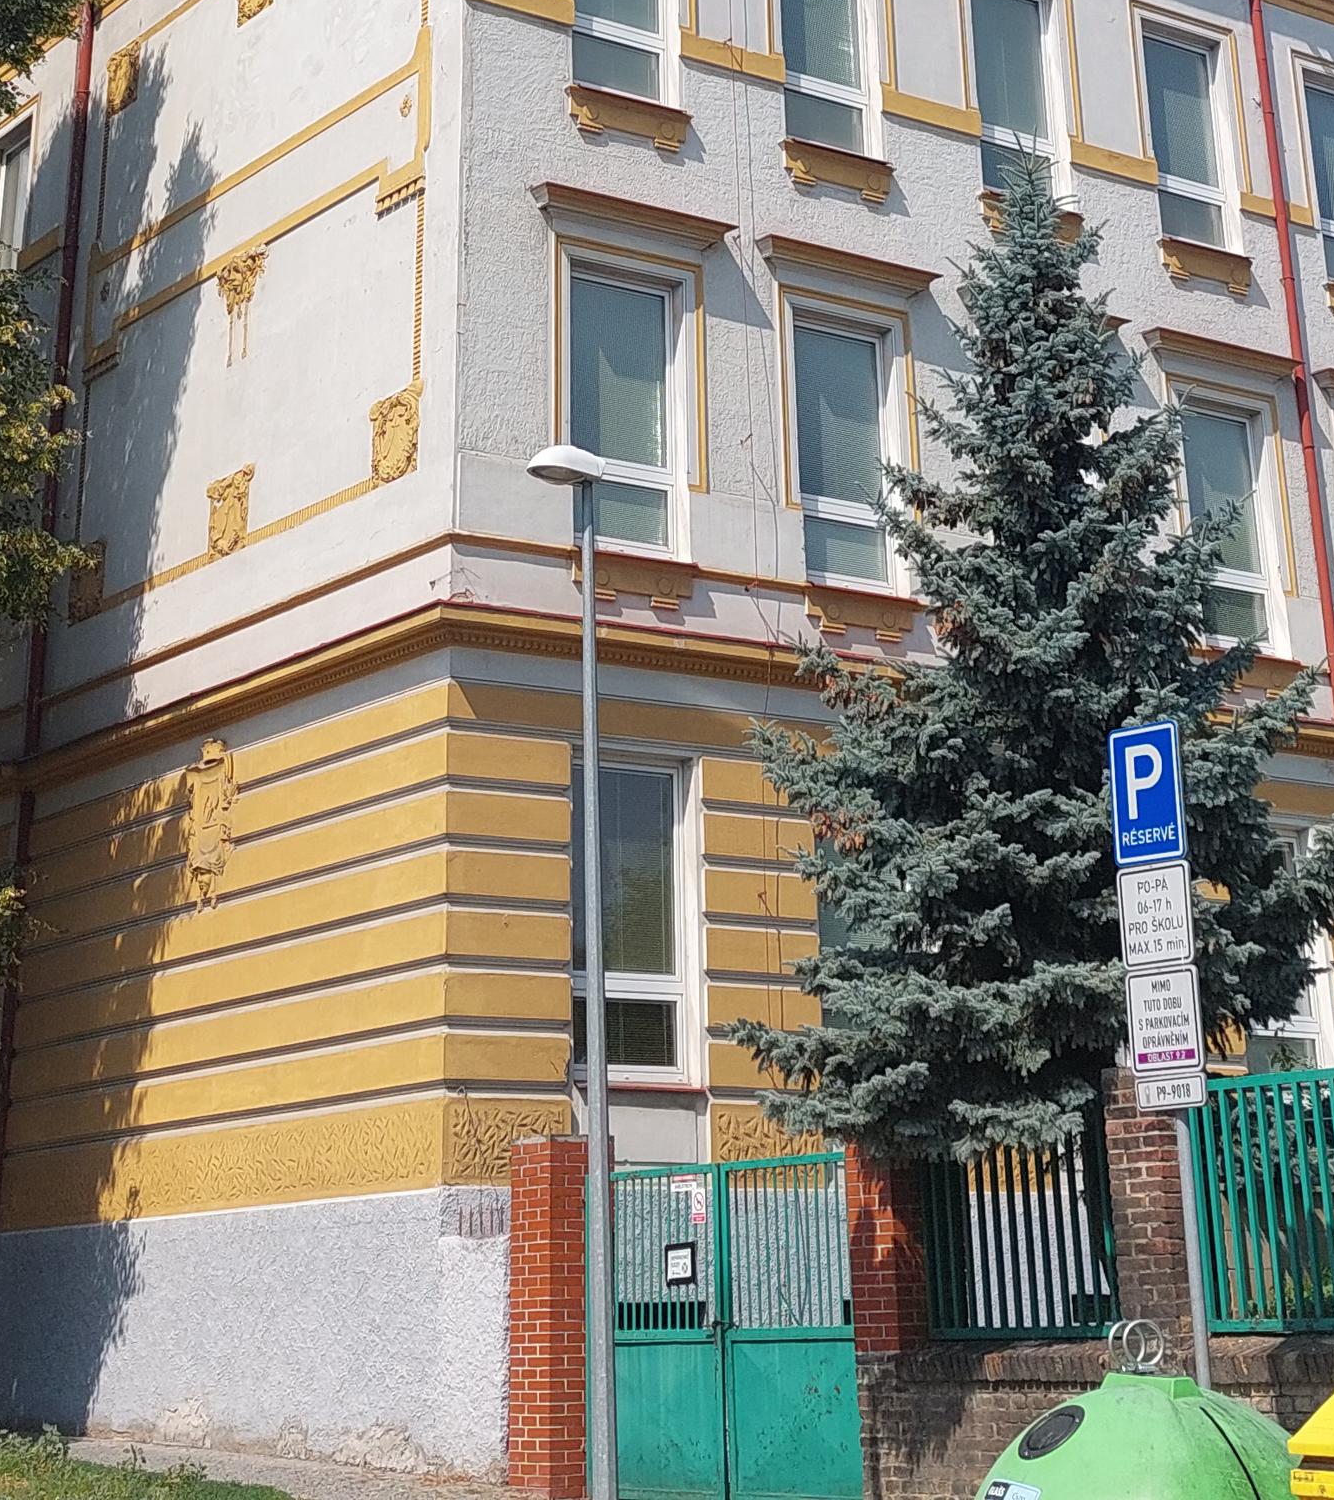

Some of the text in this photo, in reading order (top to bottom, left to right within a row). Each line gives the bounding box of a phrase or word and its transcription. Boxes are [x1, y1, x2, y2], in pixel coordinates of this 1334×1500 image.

[1124, 744, 1163, 820] P
[1122, 822, 1176, 846] RÉSERVÉ
[1137, 874, 1169, 895] PO-PÁ
[1137, 897, 1172, 915] 06-17 h
[1128, 915, 1184, 936] PRO ŠKOLU
[1167, 936, 1187, 952] min.
[1151, 979, 1171, 993] MIMO
[1143, 996, 1182, 1013] TUTO DOBU
[1138, 1011, 1190, 1031] S PARKOVACÍM
[1142, 1031, 1189, 1049] OPRÁVNĚNÍM
[1147, 1051, 1174, 1063] OBLAST
[1156, 1082, 1191, 1102] P9-9018
